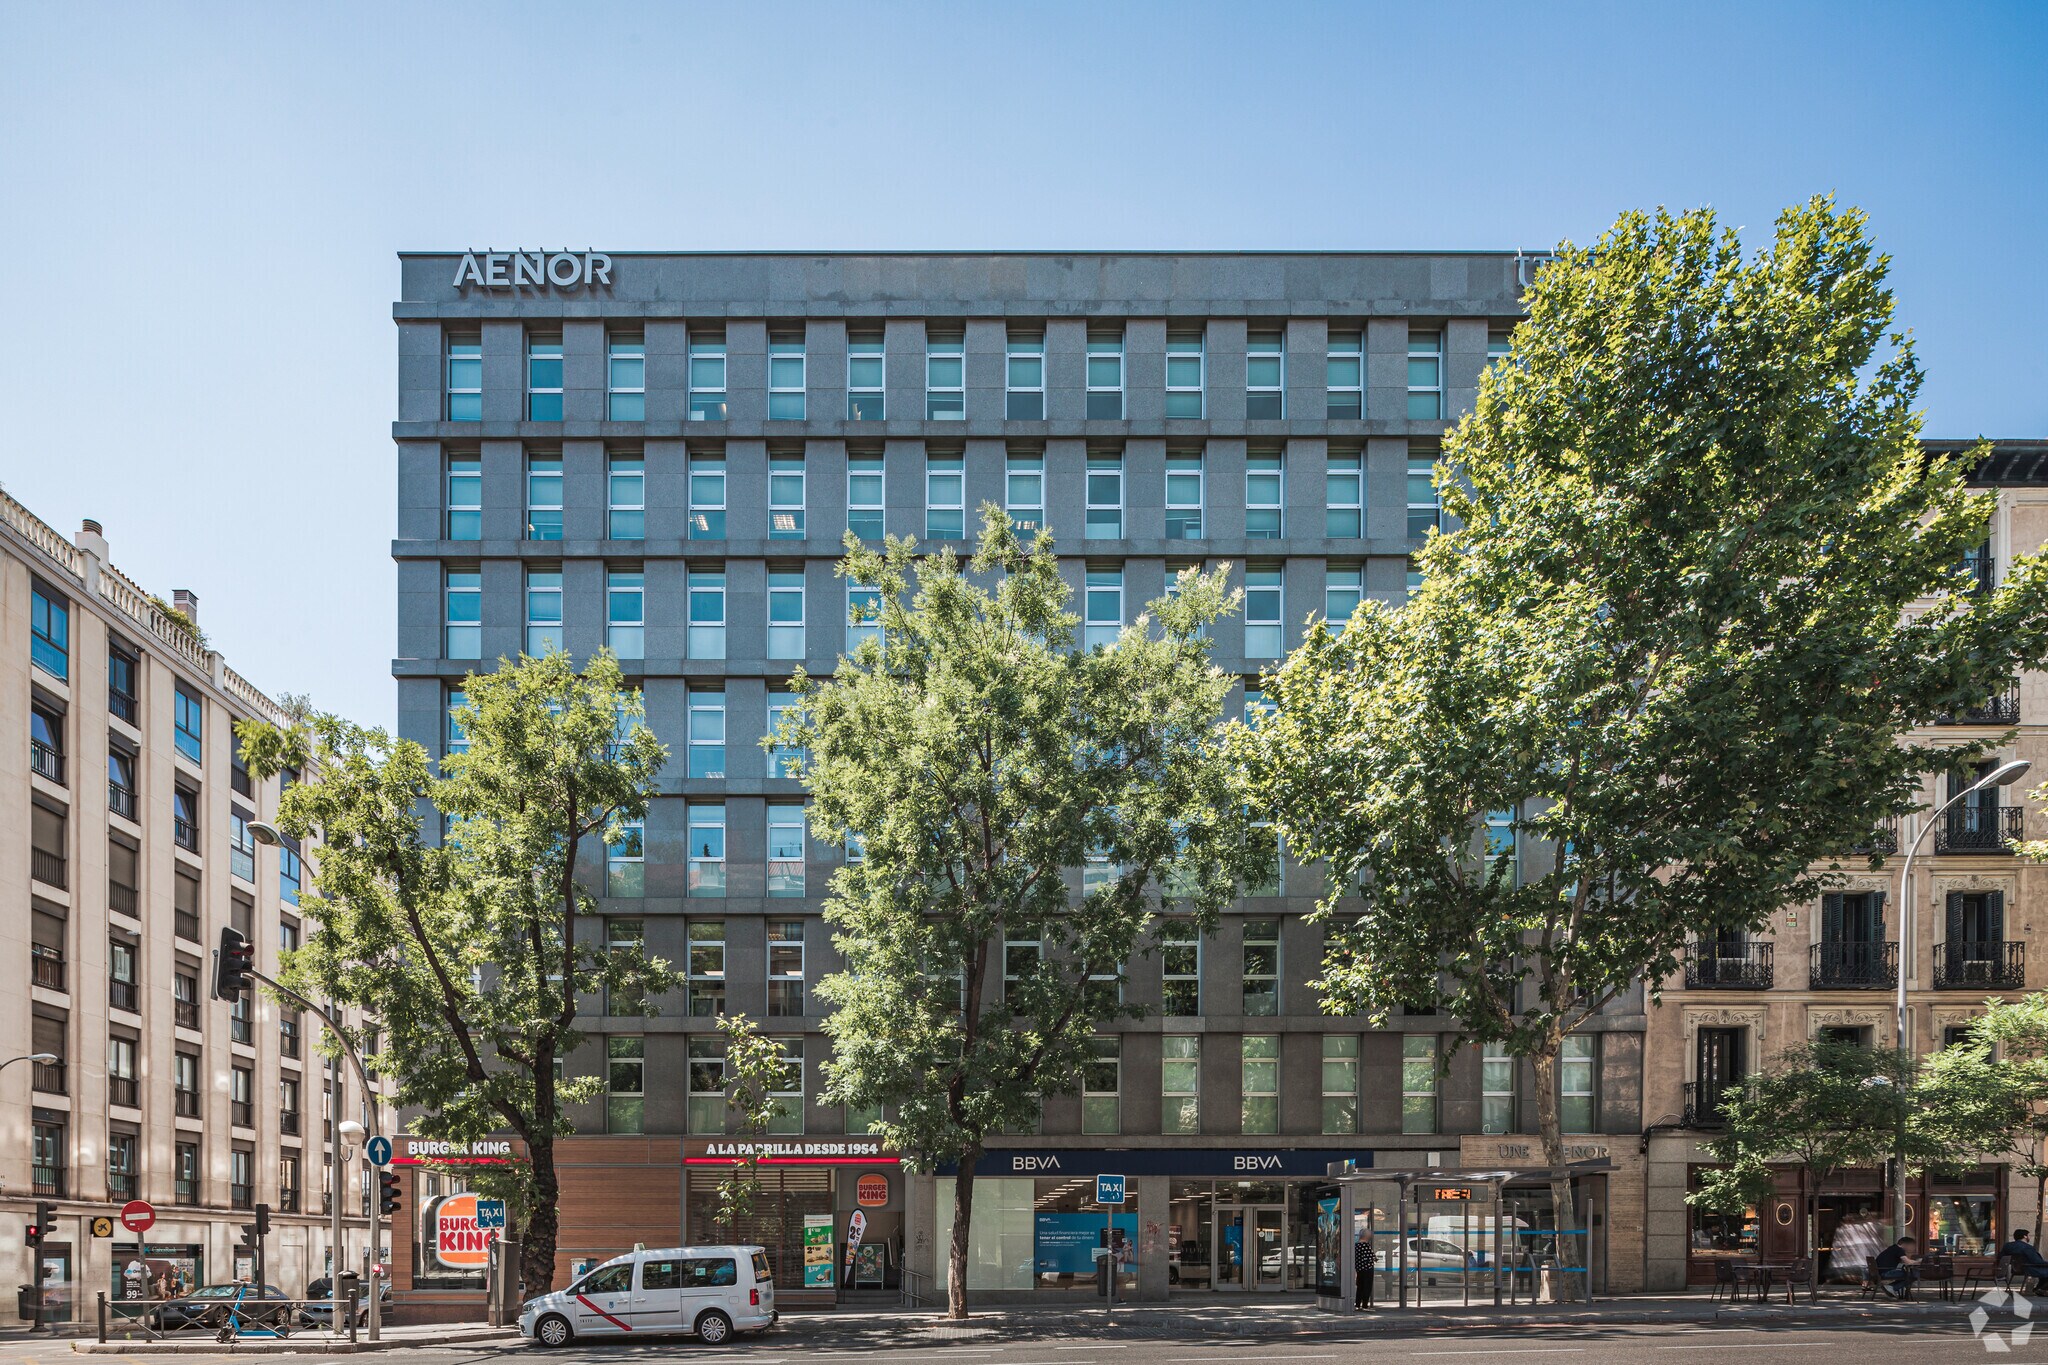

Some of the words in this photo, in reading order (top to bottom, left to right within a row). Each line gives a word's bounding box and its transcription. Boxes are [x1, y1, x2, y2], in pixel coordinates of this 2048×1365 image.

[452, 253, 612, 287] AENOR
[472, 1141, 511, 1155] KING
[706, 1143, 717, 1155] A
[718, 1143, 736, 1155] LA
[804, 1143, 846, 1155] DESDE
[847, 1143, 878, 1155] 1954
[1498, 1144, 1529, 1158] UNE
[1560, 1144, 1609, 1159] ENOR
[1012, 1155, 1061, 1170] BBVA
[1234, 1155, 1282, 1170] BBVA
[1100, 1183, 1122, 1192] TAXI
[859, 1191, 886, 1200] KING
[479, 1208, 502, 1218] TAXI
